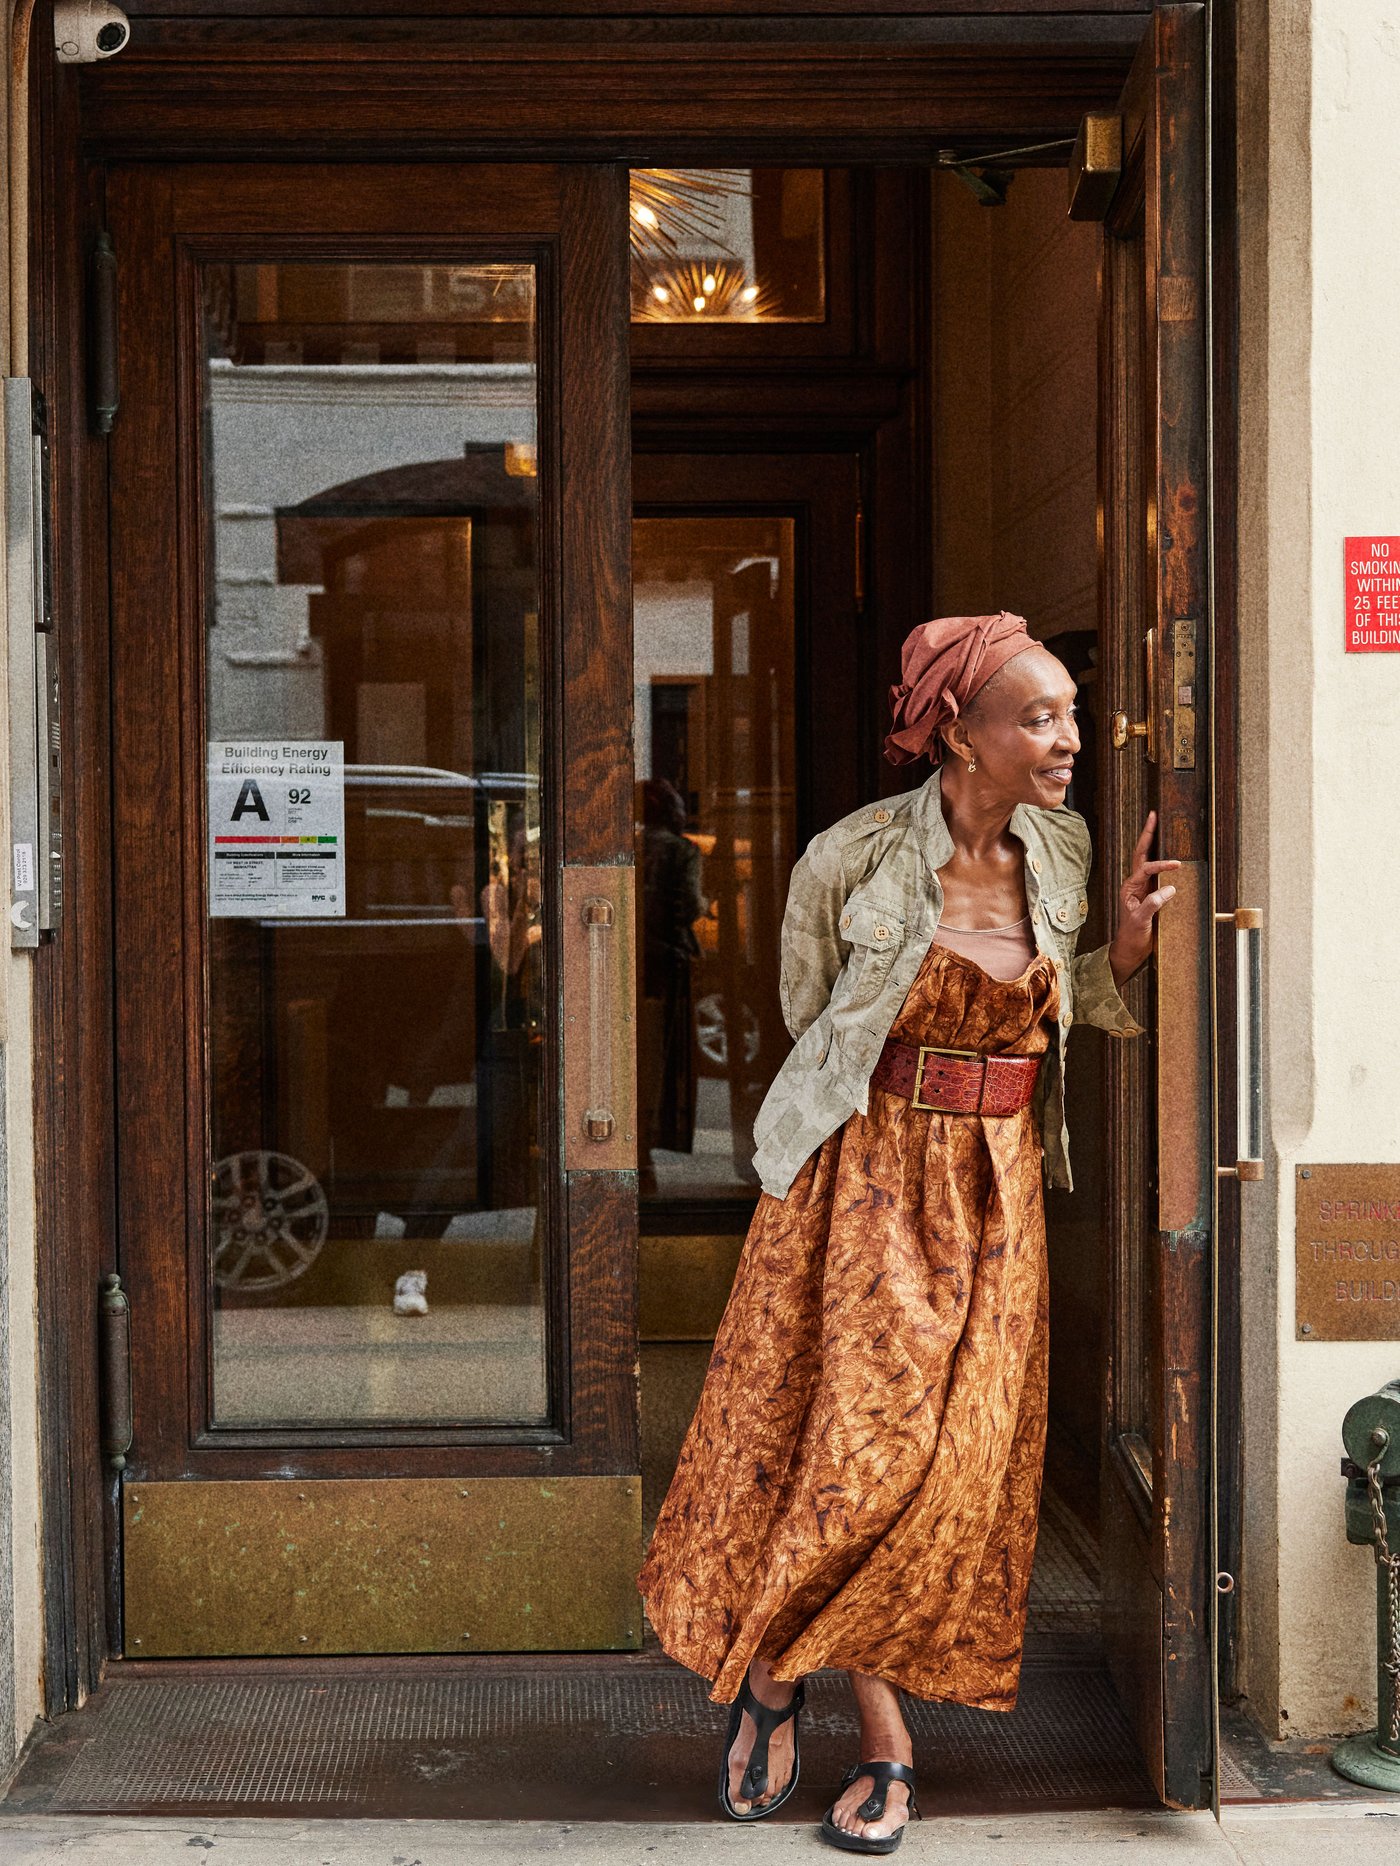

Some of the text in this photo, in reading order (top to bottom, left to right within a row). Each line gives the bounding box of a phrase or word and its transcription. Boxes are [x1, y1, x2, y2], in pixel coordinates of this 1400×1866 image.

[1371, 543, 1389, 558] NO
[1354, 595, 1400, 610] 25 FEE
[1355, 613, 1400, 627] OF THI
[224, 746, 328, 760] Building Energy
[221, 762, 331, 776] Efficiency Rating
[229, 778, 311, 821] A 92
